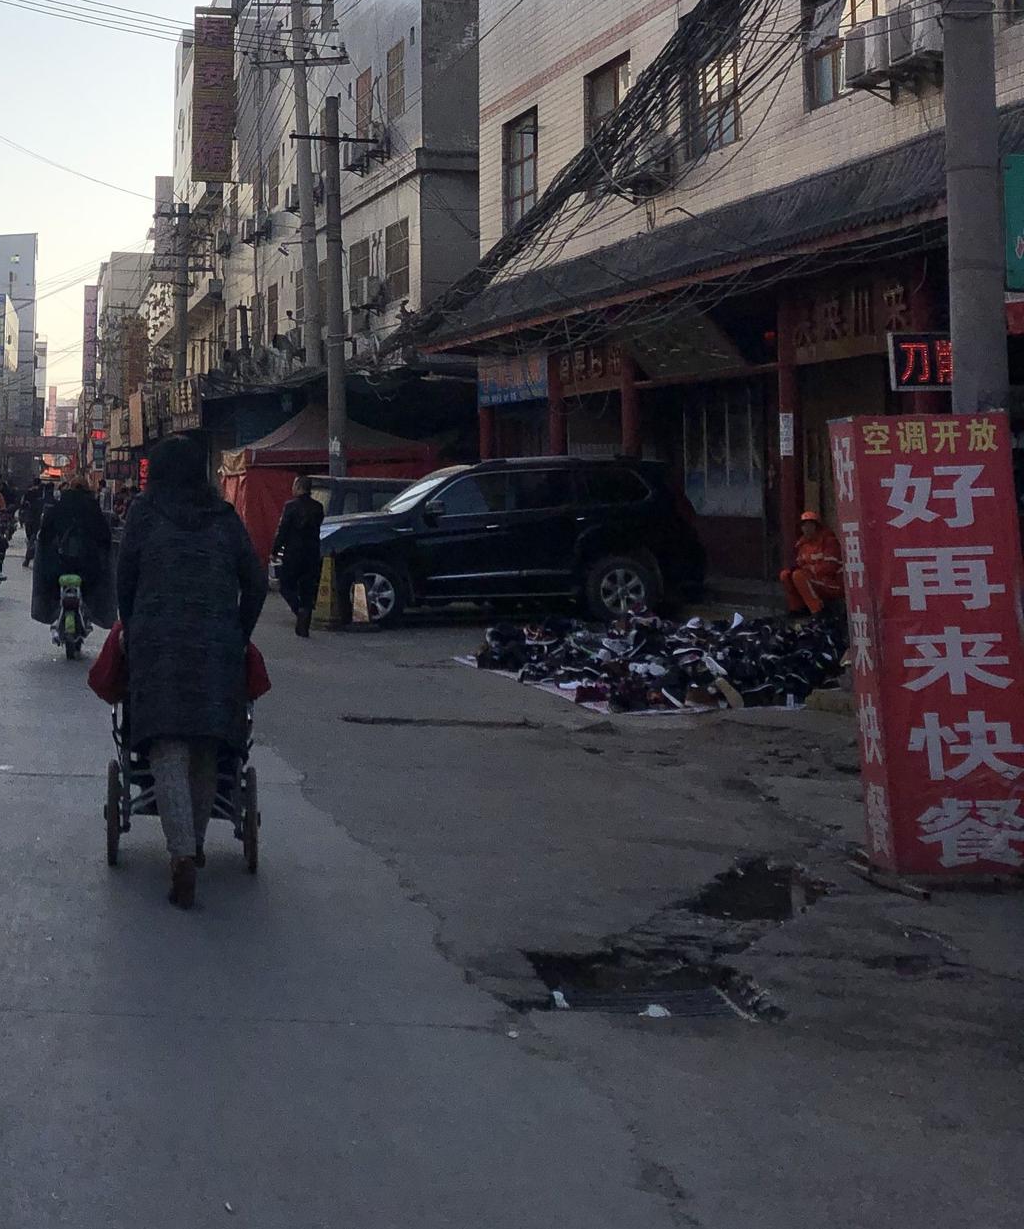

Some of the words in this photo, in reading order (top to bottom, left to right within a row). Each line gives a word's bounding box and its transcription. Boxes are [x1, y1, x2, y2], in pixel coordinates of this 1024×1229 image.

[862, 418, 1000, 456] 空调开放
[881, 463, 1024, 868] 好再来快餐
